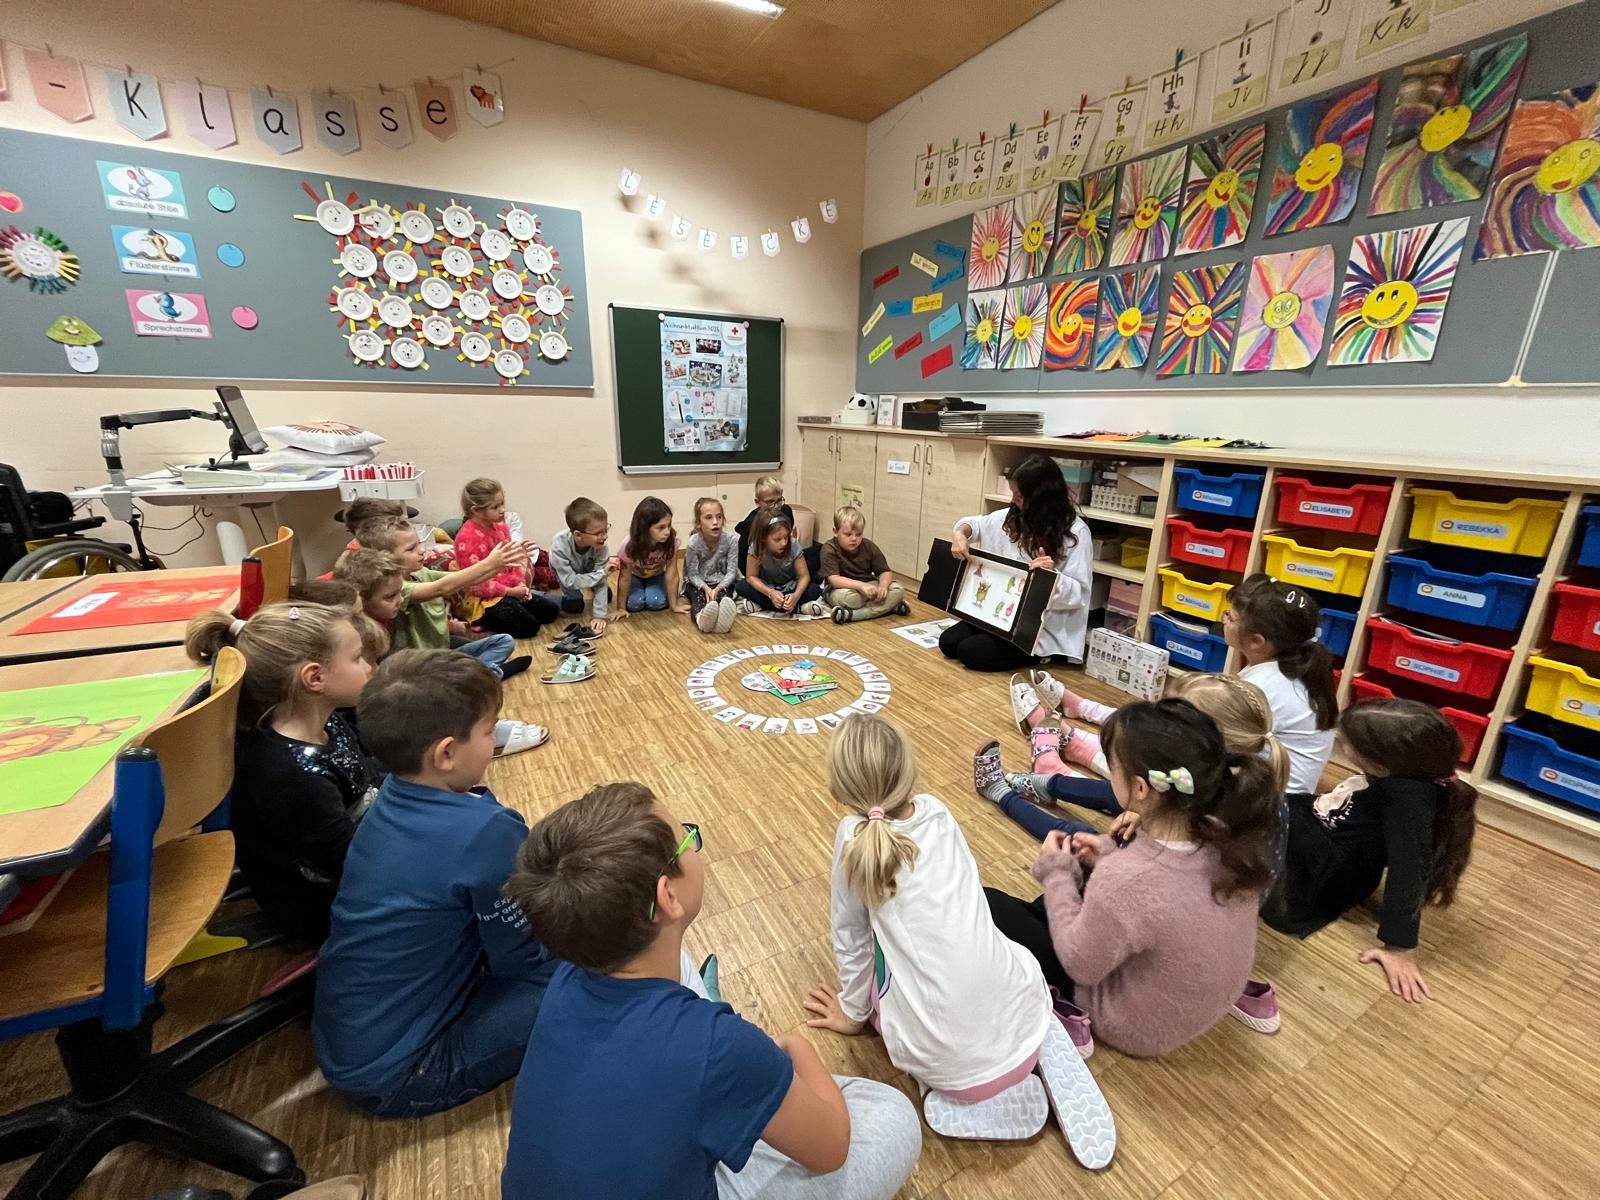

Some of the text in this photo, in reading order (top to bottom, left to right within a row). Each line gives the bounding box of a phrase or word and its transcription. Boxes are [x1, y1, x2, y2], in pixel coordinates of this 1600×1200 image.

[1162, 73, 1184, 94] Hh
[1117, 98, 1134, 115] Gg
[1075, 116, 1090, 131] Ff
[1037, 130, 1049, 144] Ee
[1004, 141, 1017, 156] Dd
[948, 156, 959, 168] Bb
[974, 150, 986, 162] Cc
[925, 161, 934, 171] Aa
[1312, 505, 1351, 516] ELISABETH
[1456, 523, 1499, 534] REBEKKA
[1297, 567, 1334, 578] KONSTANTIN
[1443, 590, 1468, 601] ANNA
[1413, 663, 1445, 677] SOPHIE
